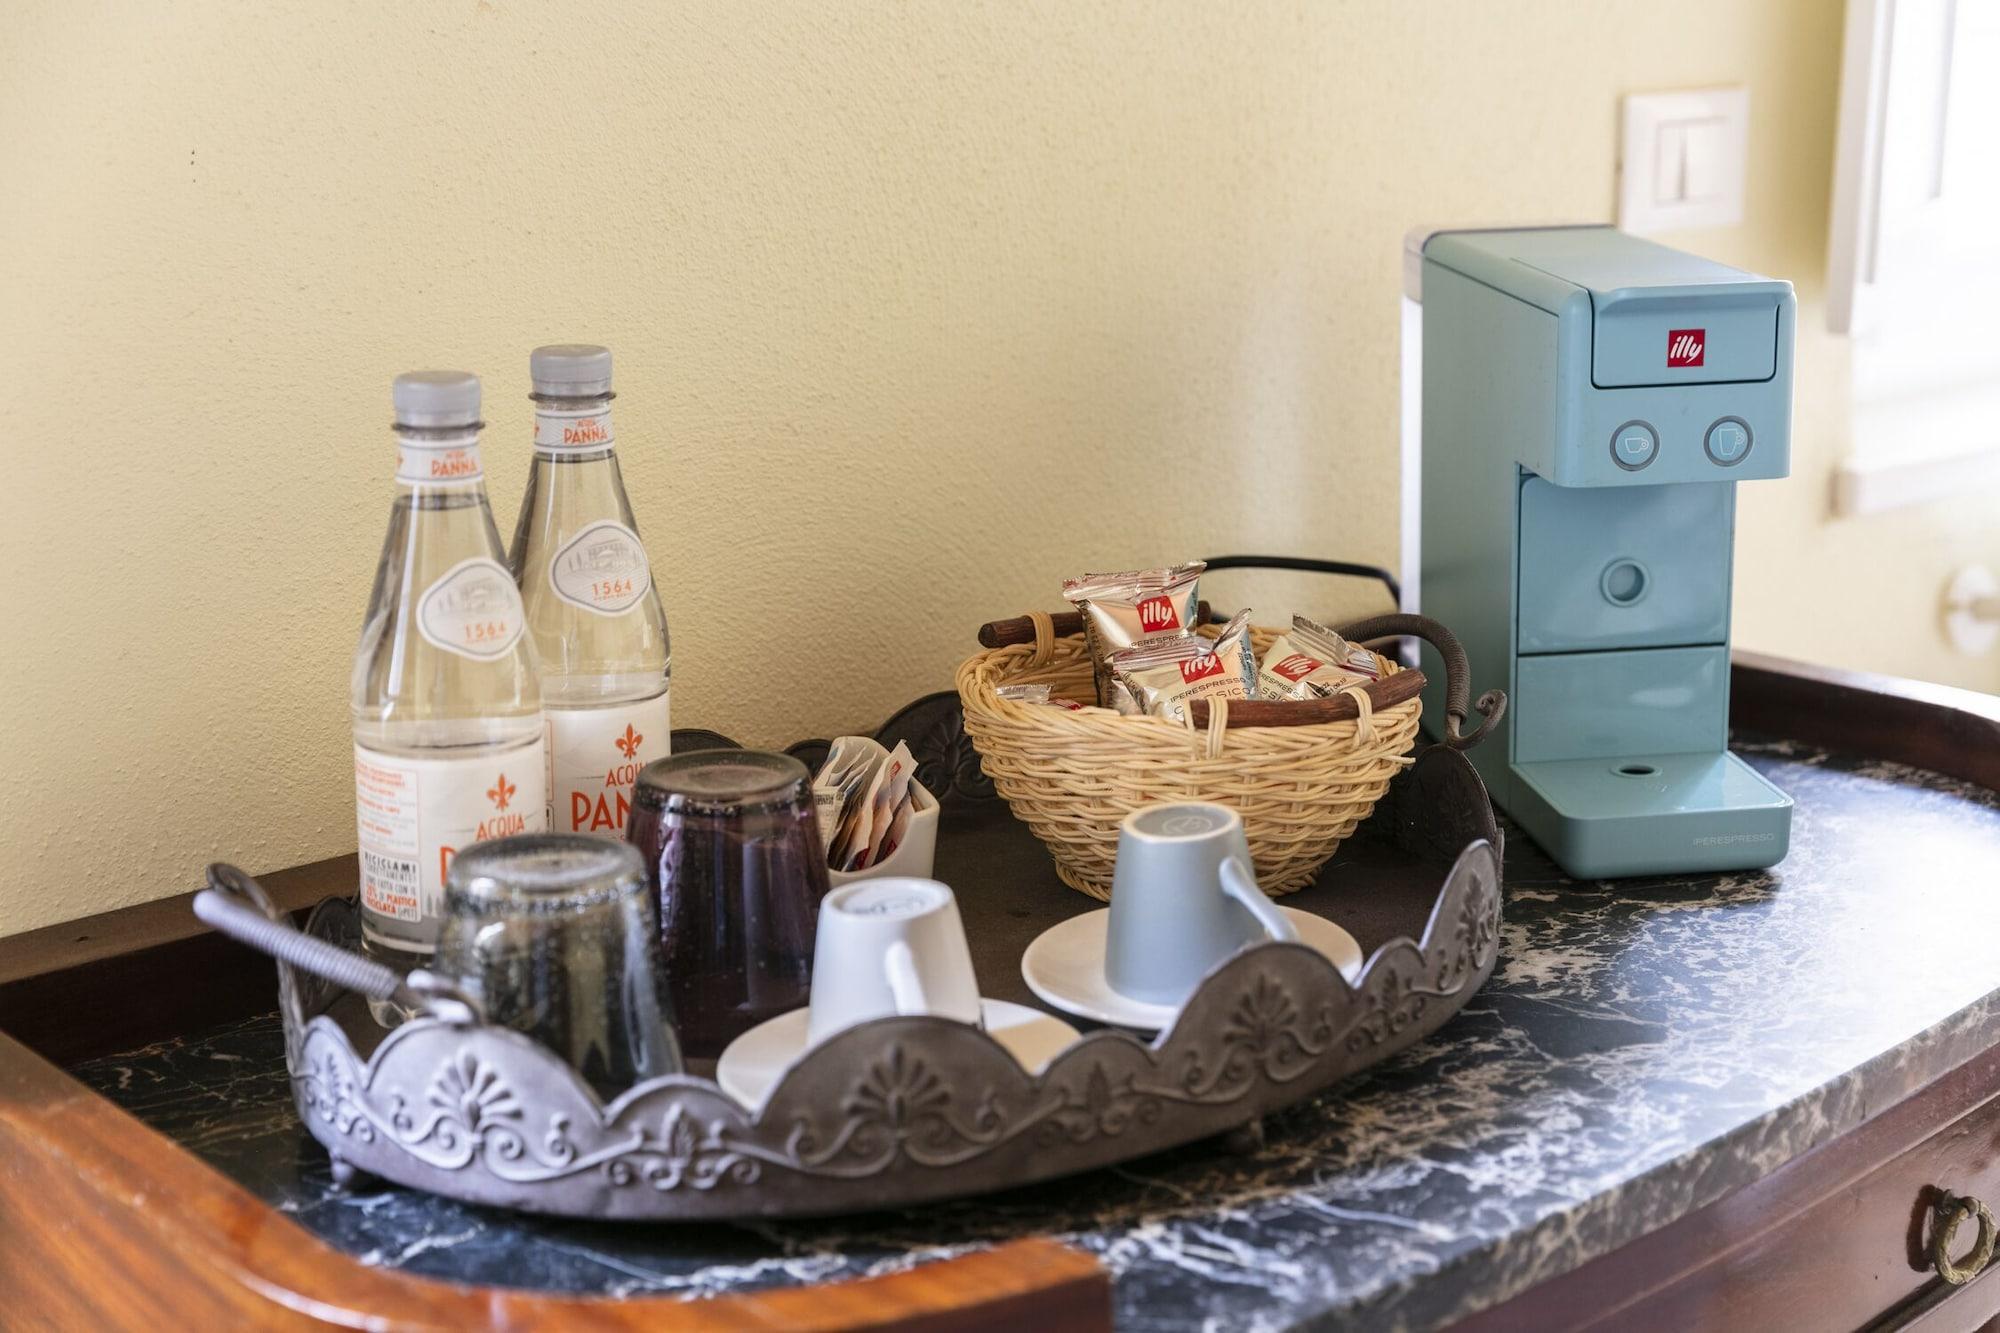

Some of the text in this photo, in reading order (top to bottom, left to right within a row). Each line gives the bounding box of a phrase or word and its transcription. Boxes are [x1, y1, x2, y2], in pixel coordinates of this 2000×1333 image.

[1669, 334, 1703, 364] illy
[563, 426, 608, 444] PANNA
[431, 459, 478, 476] PANNA
[592, 578, 632, 596] 1564
[1142, 600, 1173, 627] illy
[465, 621, 506, 639] 1564
[1170, 677, 1247, 703] IPERESPRESSO
[605, 762, 647, 788] ACQU
[571, 790, 632, 832] PAN
[476, 813, 525, 842] ACQUA
[1693, 832, 1775, 847] IPERESPRESSO
